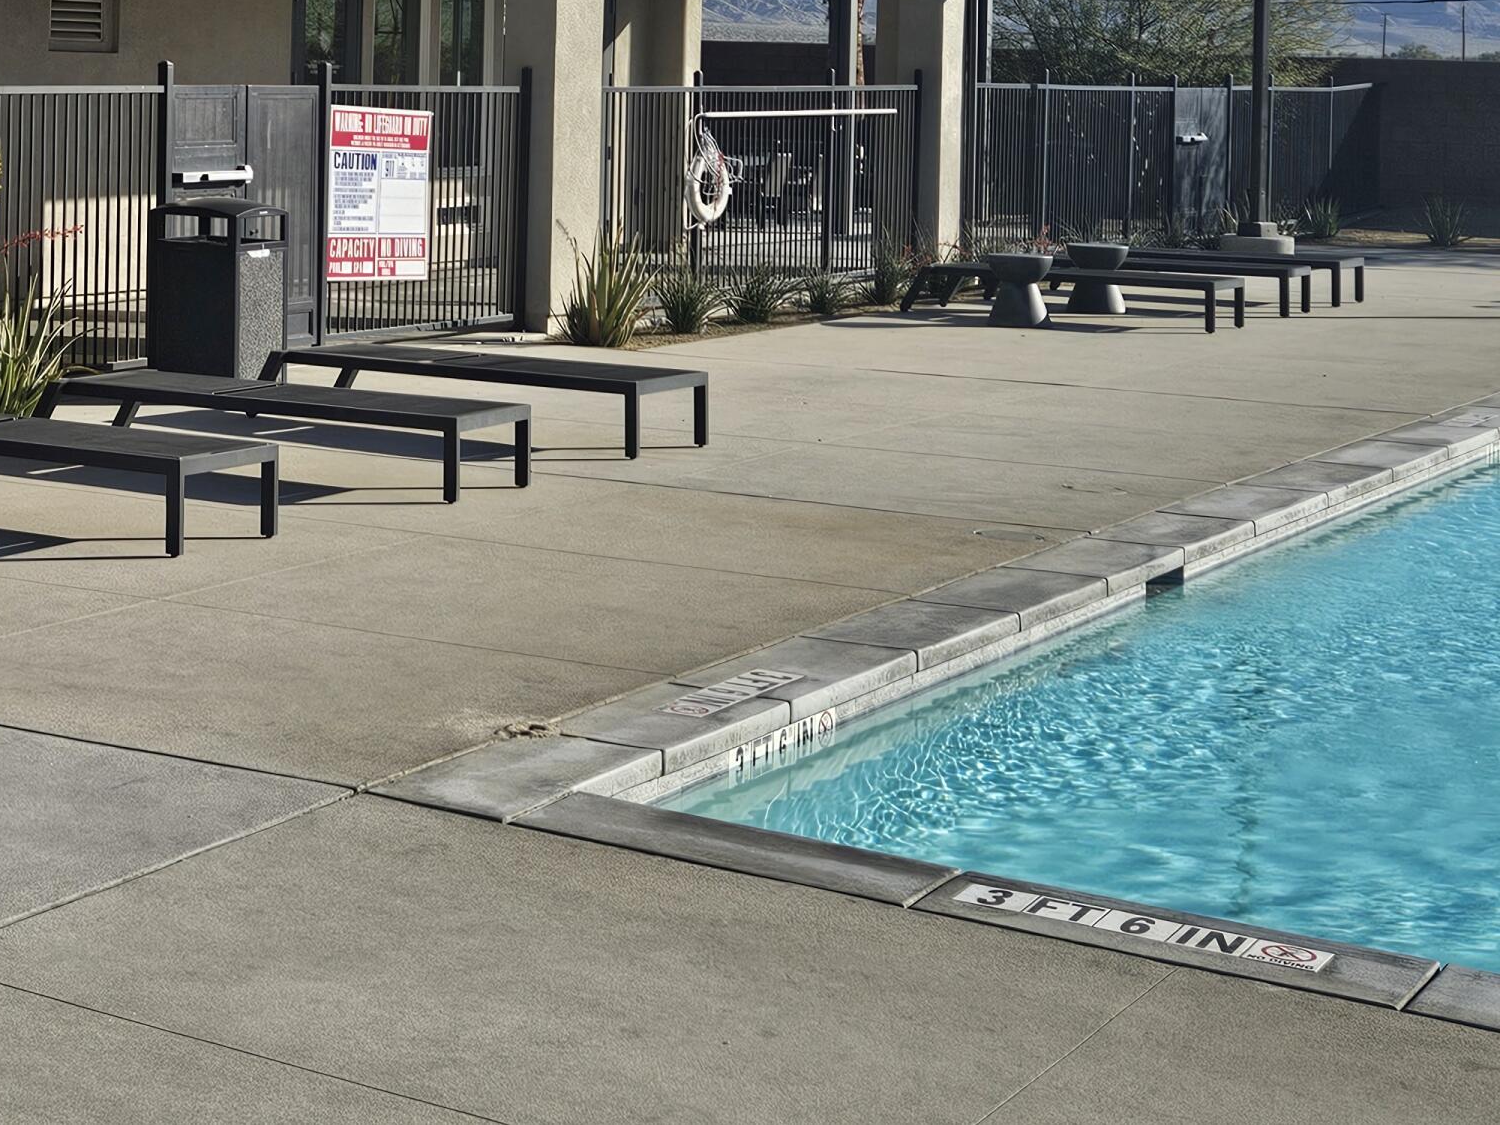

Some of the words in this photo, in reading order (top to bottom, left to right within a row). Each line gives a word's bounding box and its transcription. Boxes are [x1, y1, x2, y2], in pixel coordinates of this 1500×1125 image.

[334, 152, 378, 170] CAUTION
[385, 160, 395, 177] 911
[329, 238, 375, 258] CAPACITY
[380, 238, 392, 257] NO
[394, 238, 423, 257] DIVING
[976, 889, 1014, 906] 3
[1026, 896, 1106, 922] FT
[1119, 916, 1156, 935] 6
[1175, 926, 1248, 955] IN
[1269, 958, 1314, 970] DIVING
